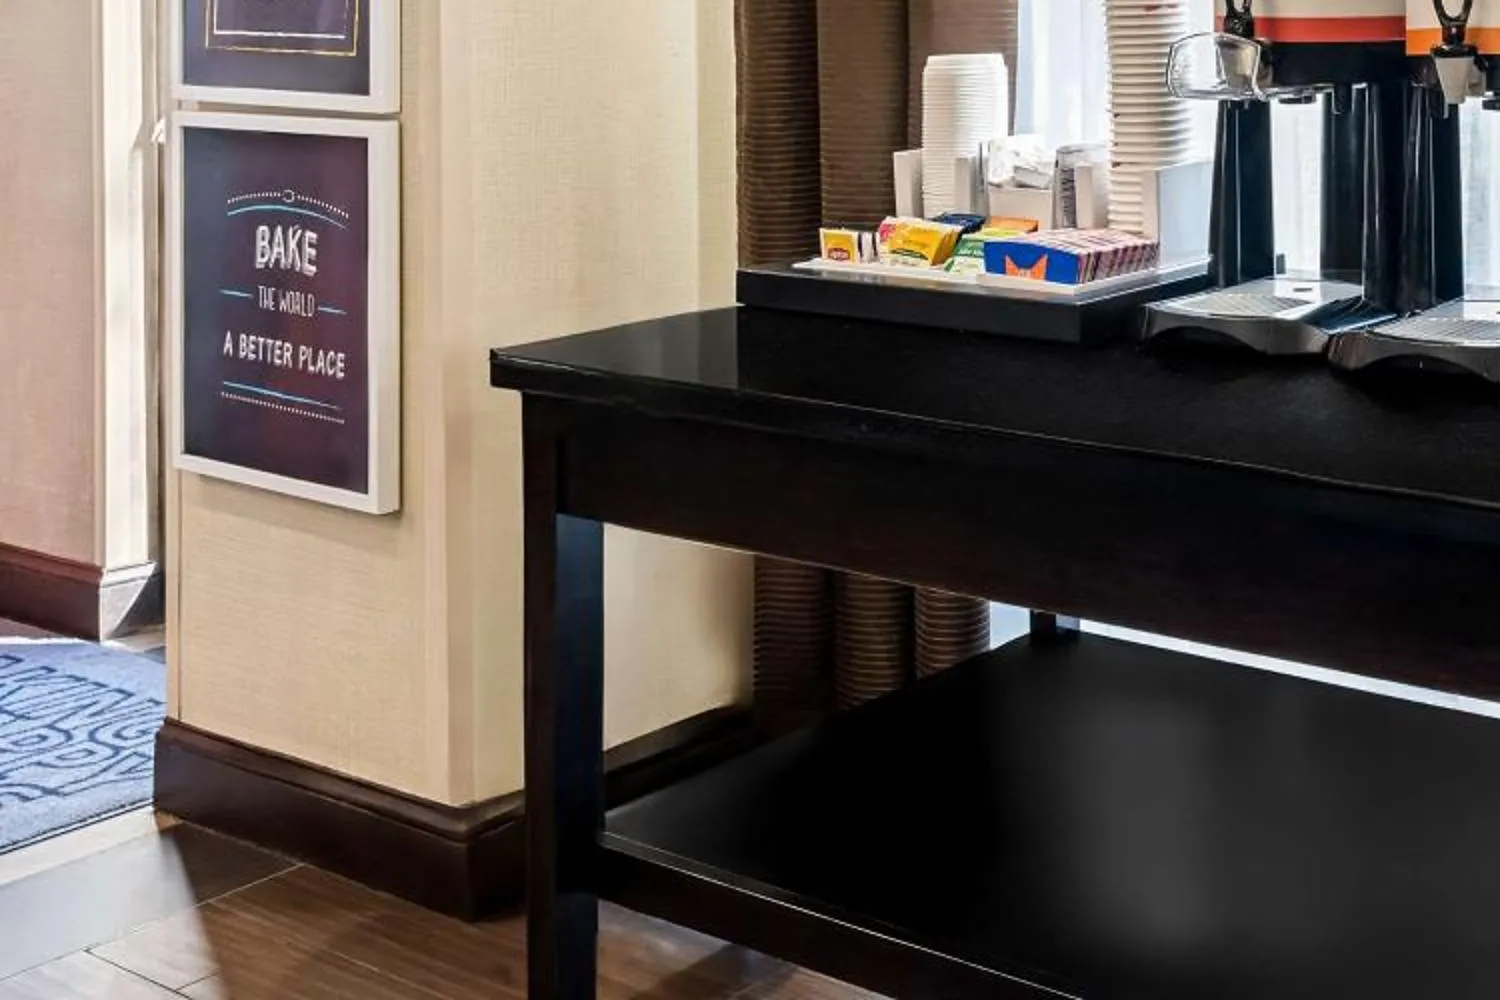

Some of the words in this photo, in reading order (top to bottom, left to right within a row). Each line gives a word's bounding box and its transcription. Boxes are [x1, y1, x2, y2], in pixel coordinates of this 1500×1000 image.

[255, 223, 318, 277] BAKE
[258, 285, 276, 311] THE
[279, 289, 315, 318] WORLD
[223, 329, 234, 357] A
[239, 332, 294, 369] BETTER
[298, 345, 346, 380] PLACE
